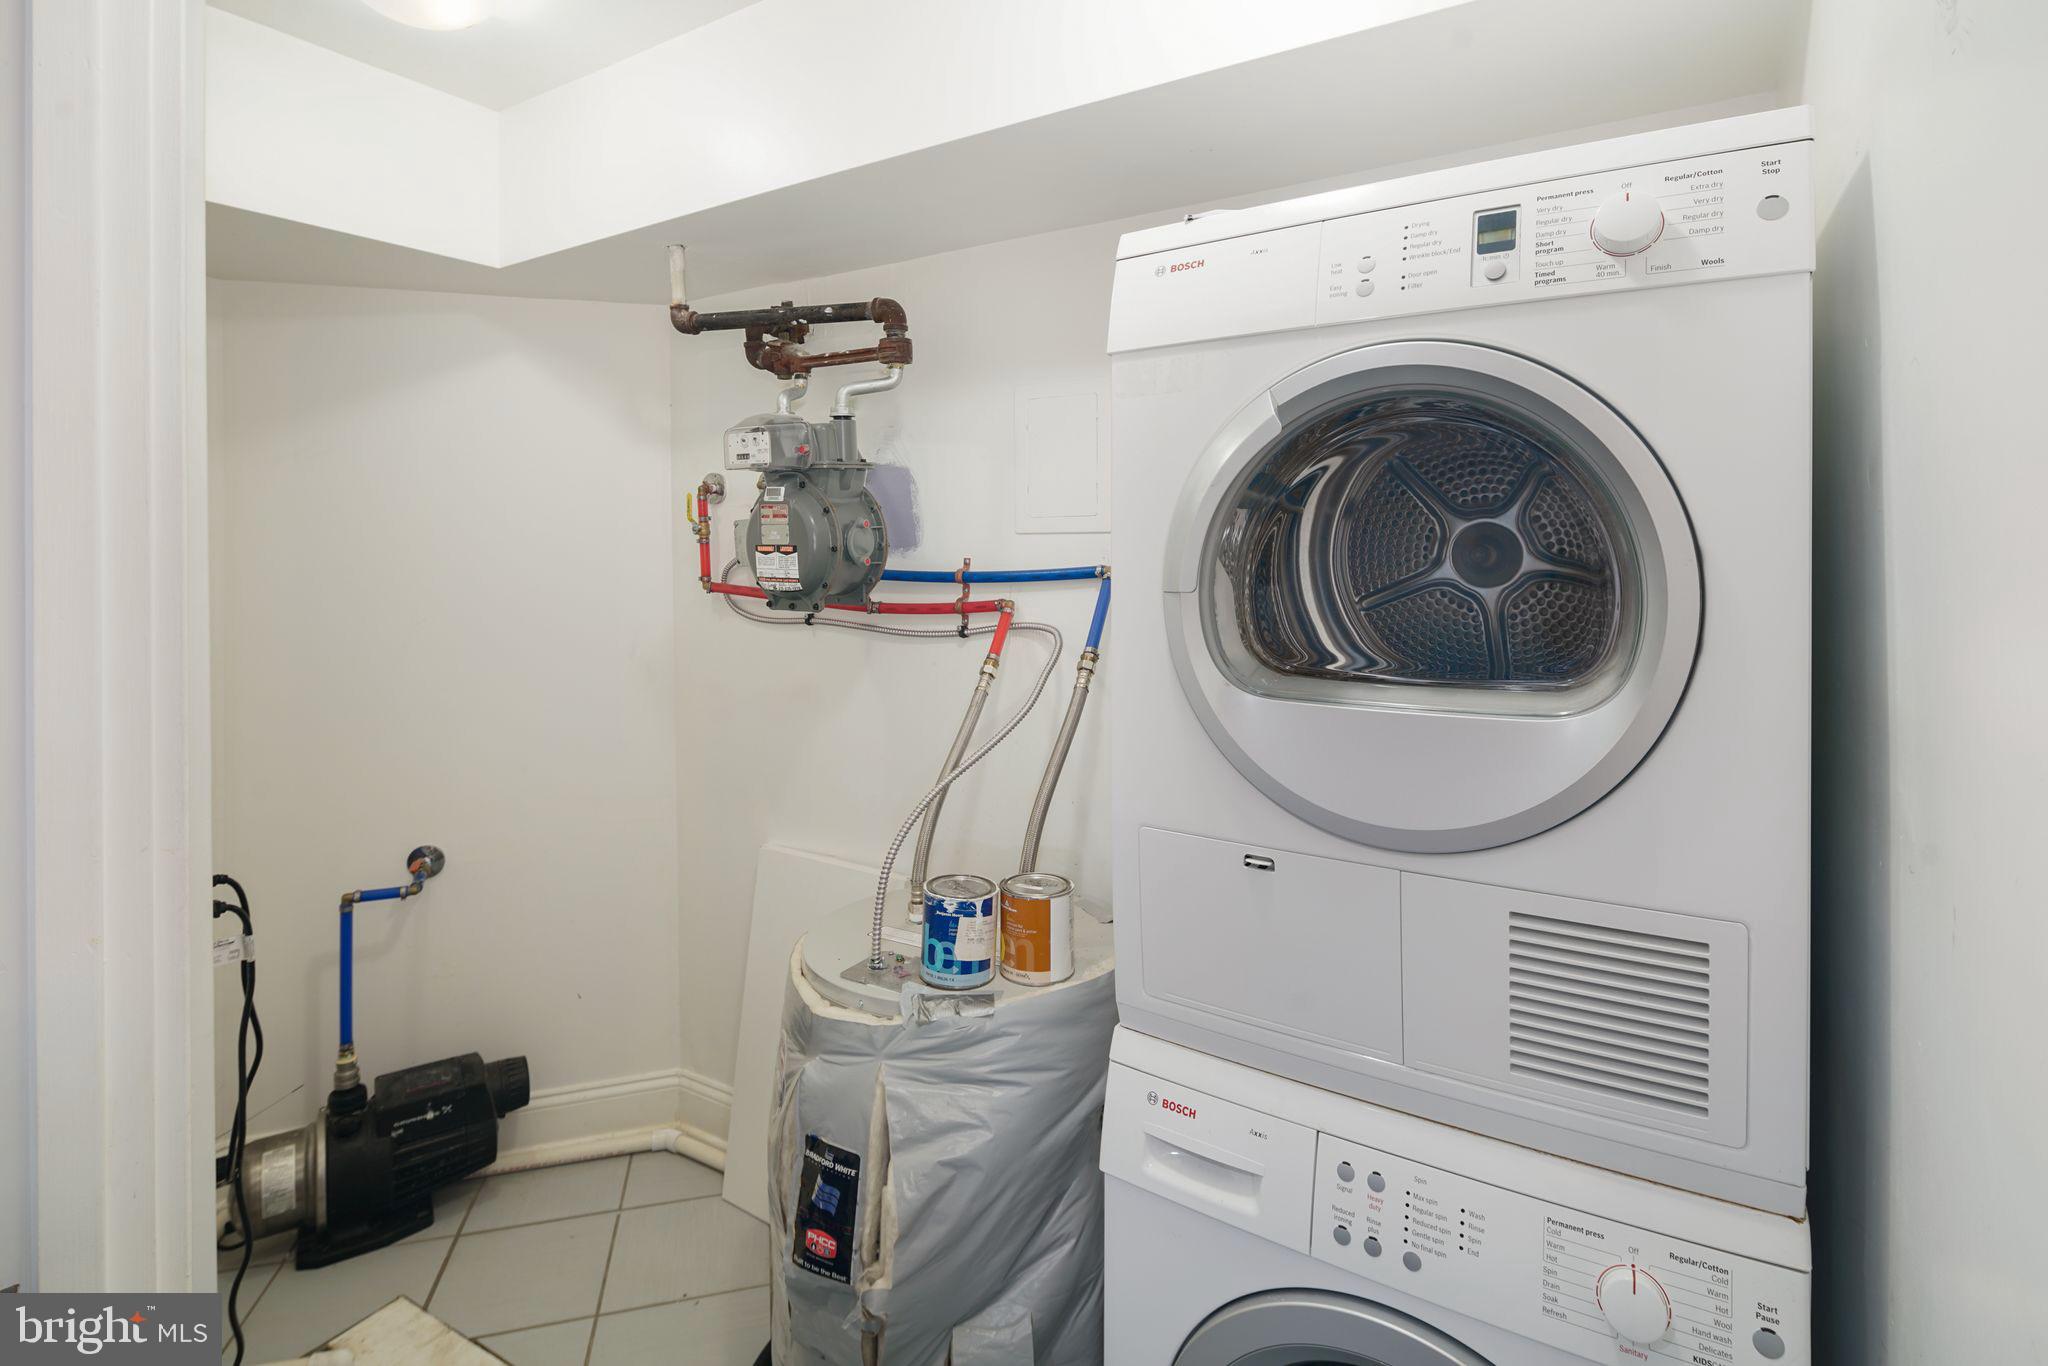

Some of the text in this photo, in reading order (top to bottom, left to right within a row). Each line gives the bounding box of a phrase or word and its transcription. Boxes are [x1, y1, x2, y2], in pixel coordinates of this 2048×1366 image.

[1761, 159, 1781, 167] Start
[1664, 168, 1723, 182] Regular/Cotton
[1762, 167, 1781, 175] Stop
[1621, 182, 1632, 190] Off
[1690, 181, 1724, 191] Extra dry
[1536, 188, 1594, 201] Permanent press
[1693, 195, 1724, 206] Very dry
[1682, 209, 1724, 222] Regular dry
[1536, 218, 1559, 226] Regular
[1536, 231, 1554, 239] Damp
[1688, 224, 1724, 236] Damp dry
[1535, 246, 1564, 255] program
[1170, 259, 1205, 273] BOSCH
[1596, 263, 1616, 271] Warm
[1650, 263, 1672, 272] Finish
[1700, 258, 1725, 266] Wools
[1535, 270, 1555, 278] Timed
[1534, 277, 1567, 286] programs
[1162, 1099, 1196, 1119] BOSCH
[1249, 1128, 1268, 1140] Axxis
[805, 1149, 834, 1168] BRADFORD
[835, 1163, 856, 1177] WHITE
[1414, 1176, 1427, 1186] Spin
[1336, 1183, 1353, 1194] Signal
[1367, 1193, 1384, 1205] Heavy
[1413, 1192, 1438, 1206] Max spin
[1332, 1204, 1355, 1218] Reduced
[1368, 1203, 1382, 1213] duty
[1412, 1205, 1448, 1222] Regular spin
[1333, 1214, 1353, 1226] ironing
[1366, 1216, 1382, 1227] Rinse
[1468, 1210, 1485, 1221] Wash
[1367, 1226, 1379, 1235] plus
[1412, 1217, 1451, 1236] Reduced spin
[1468, 1222, 1485, 1234] Rinse
[1546, 1227, 1561, 1236] Cold
[1547, 1217, 1605, 1240] Permanent press
[1412, 1229, 1445, 1246] Gentle spin
[1468, 1235, 1482, 1246] Spin
[1411, 1241, 1447, 1259] No final spin
[1546, 1240, 1565, 1251] Warm
[1628, 1246, 1639, 1255] Off
[1467, 1248, 1480, 1258] End
[1546, 1254, 1558, 1263] Hot
[1669, 1252, 1729, 1275] Regular/Cotton
[1543, 1266, 1558, 1277] Spin
[1543, 1279, 1561, 1291] Drain
[1711, 1274, 1729, 1286] Cold
[1542, 1293, 1559, 1304] Soak
[1707, 1288, 1729, 1301] Warm
[1542, 1306, 1568, 1320] Refresh
[1715, 1304, 1729, 1316] Hot
[1757, 1302, 1778, 1315] Start
[1713, 1318, 1732, 1331] Wool
[1755, 1312, 1780, 1326] Pause
[1691, 1326, 1733, 1345] Hand wash
[1619, 1345, 1648, 1360] Sanitary
[1698, 1343, 1733, 1360] Delicates
